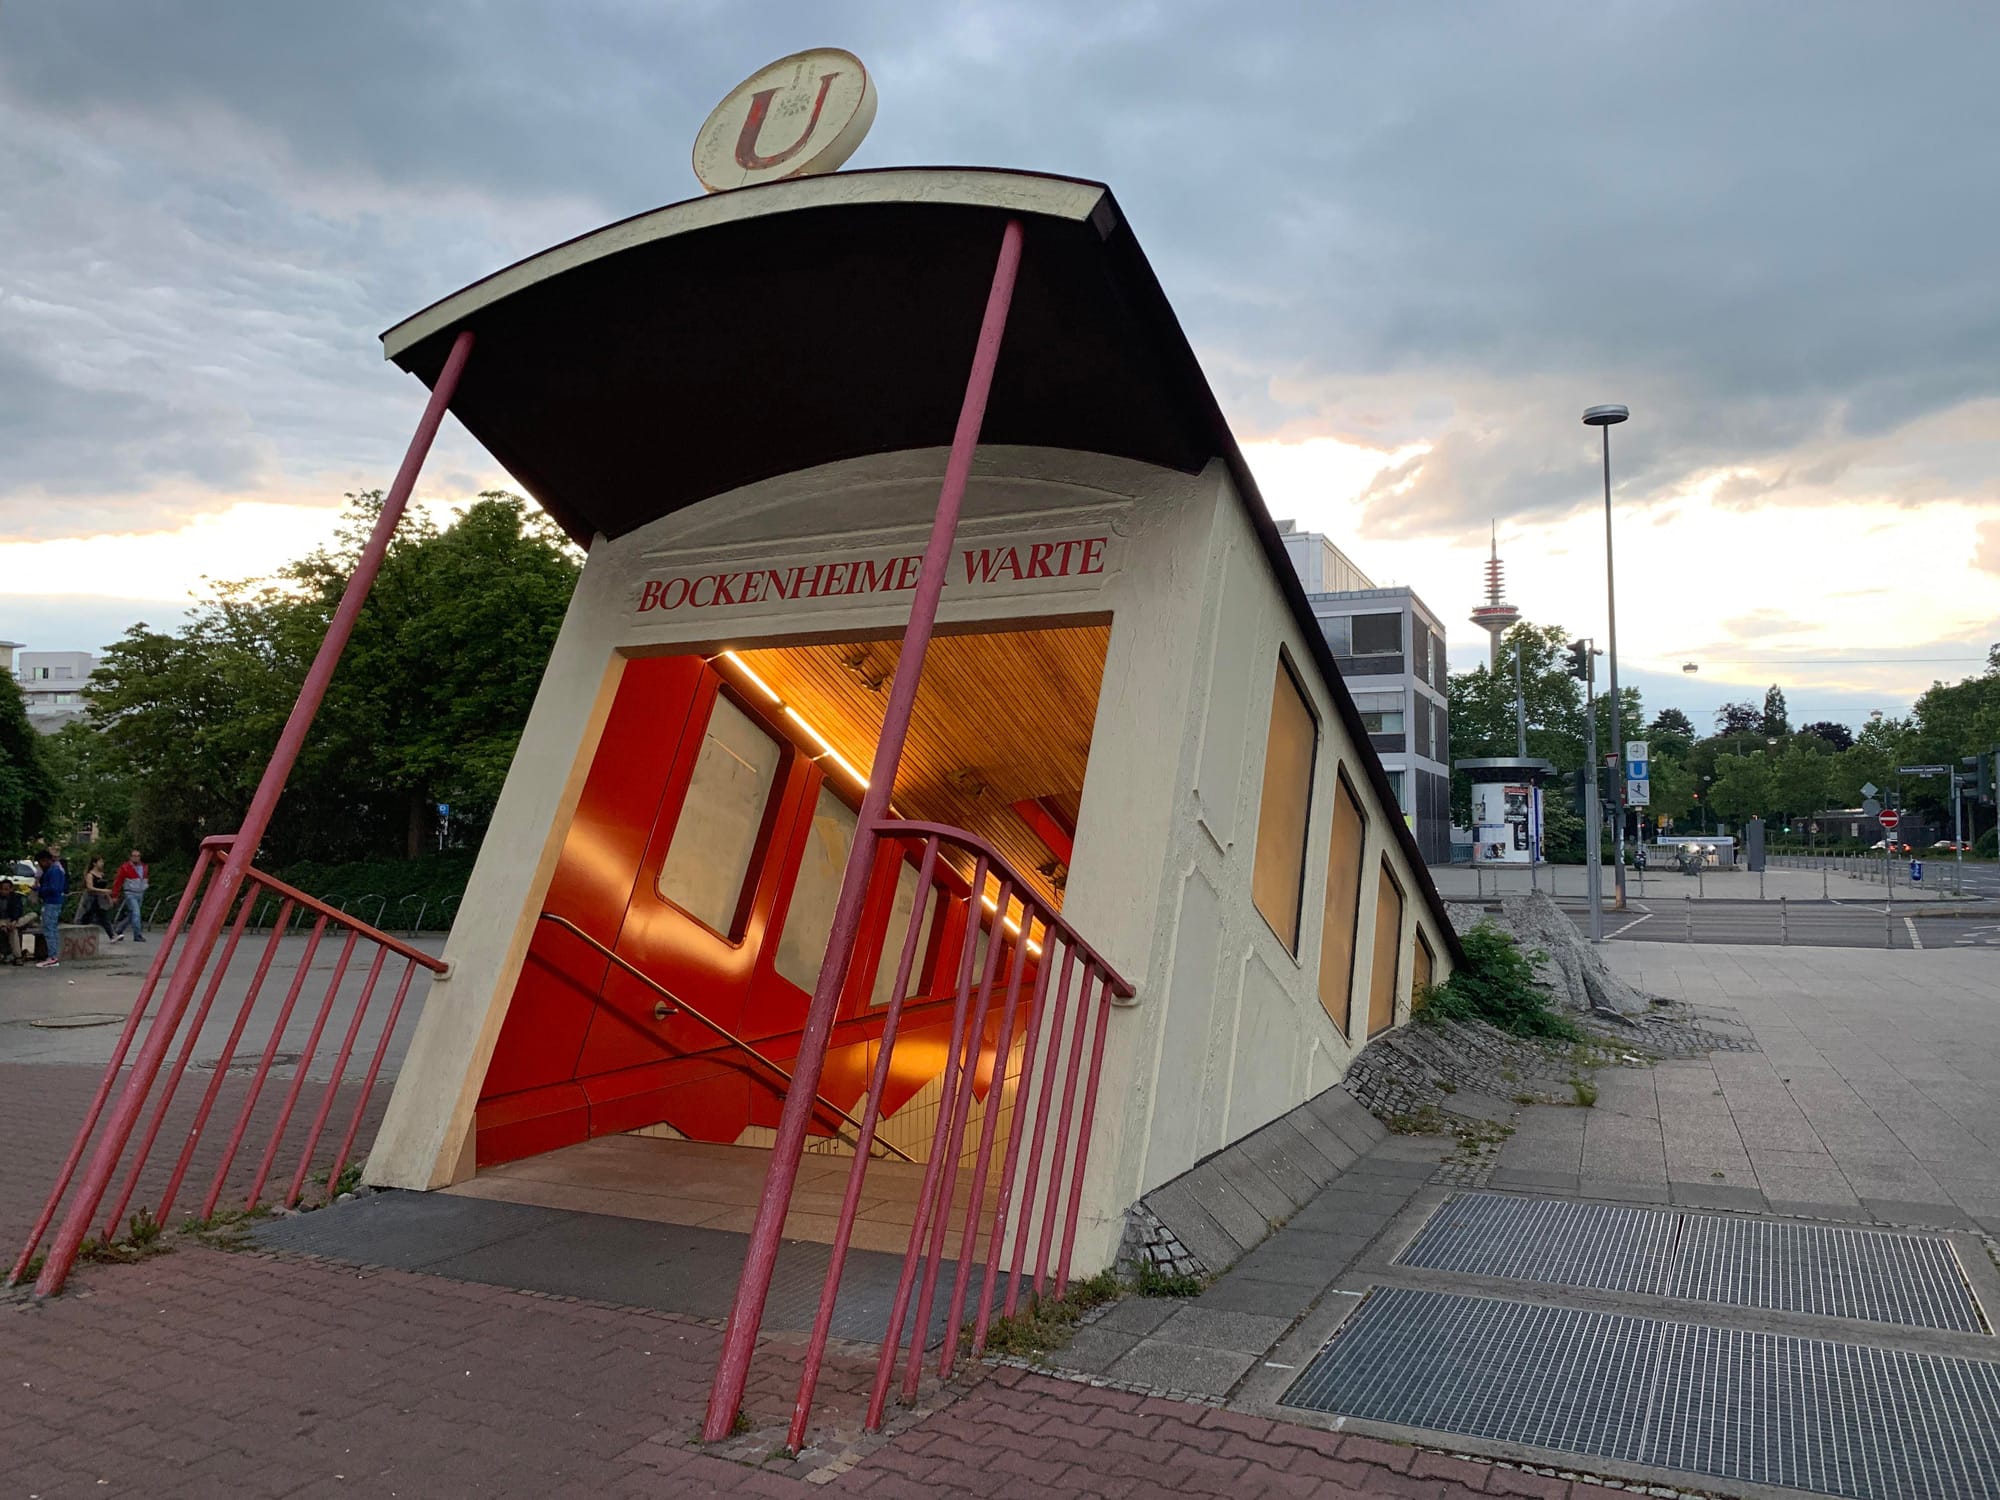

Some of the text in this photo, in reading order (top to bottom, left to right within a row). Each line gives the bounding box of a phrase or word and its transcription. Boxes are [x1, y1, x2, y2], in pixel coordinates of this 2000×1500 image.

[735, 72, 842, 170] U
[638, 537, 1108, 612] BOCKENHEIME WARTE
[1629, 762, 1647, 779] U
